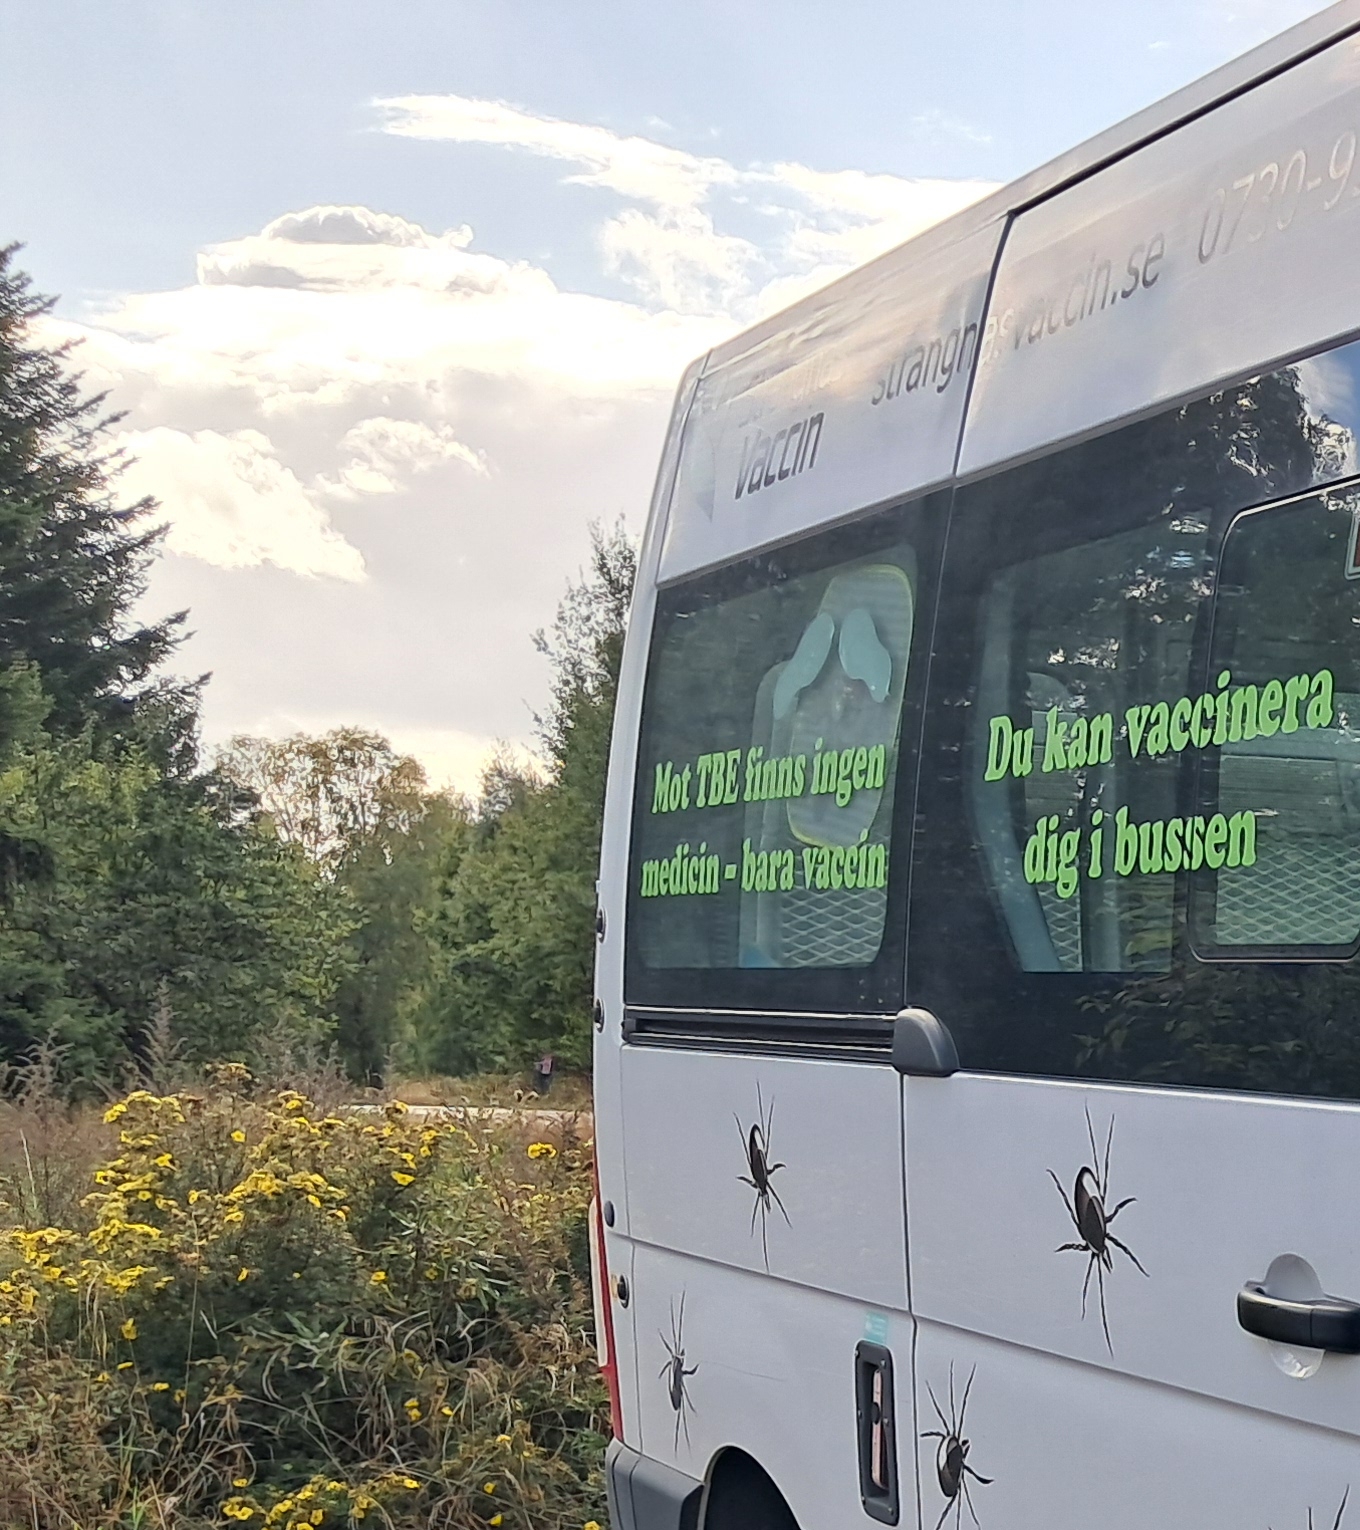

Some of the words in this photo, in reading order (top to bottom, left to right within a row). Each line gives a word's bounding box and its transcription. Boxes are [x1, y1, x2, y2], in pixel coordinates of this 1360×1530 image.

[734, 405, 825, 500] Vaccin
[984, 715, 1034, 781] Du
[1042, 705, 1114, 773] kan
[1125, 669, 1334, 758] vaccinera
[652, 760, 692, 814] Mot
[696, 748, 741, 808] TBE
[743, 745, 806, 802] finns
[811, 737, 886, 808] ingen
[640, 840, 720, 898] medicin
[741, 836, 794, 892] bara
[801, 828, 886, 890] vaccin
[1023, 814, 1082, 899] dig
[1088, 808, 1103, 880] i
[1114, 805, 1257, 877] bussen
